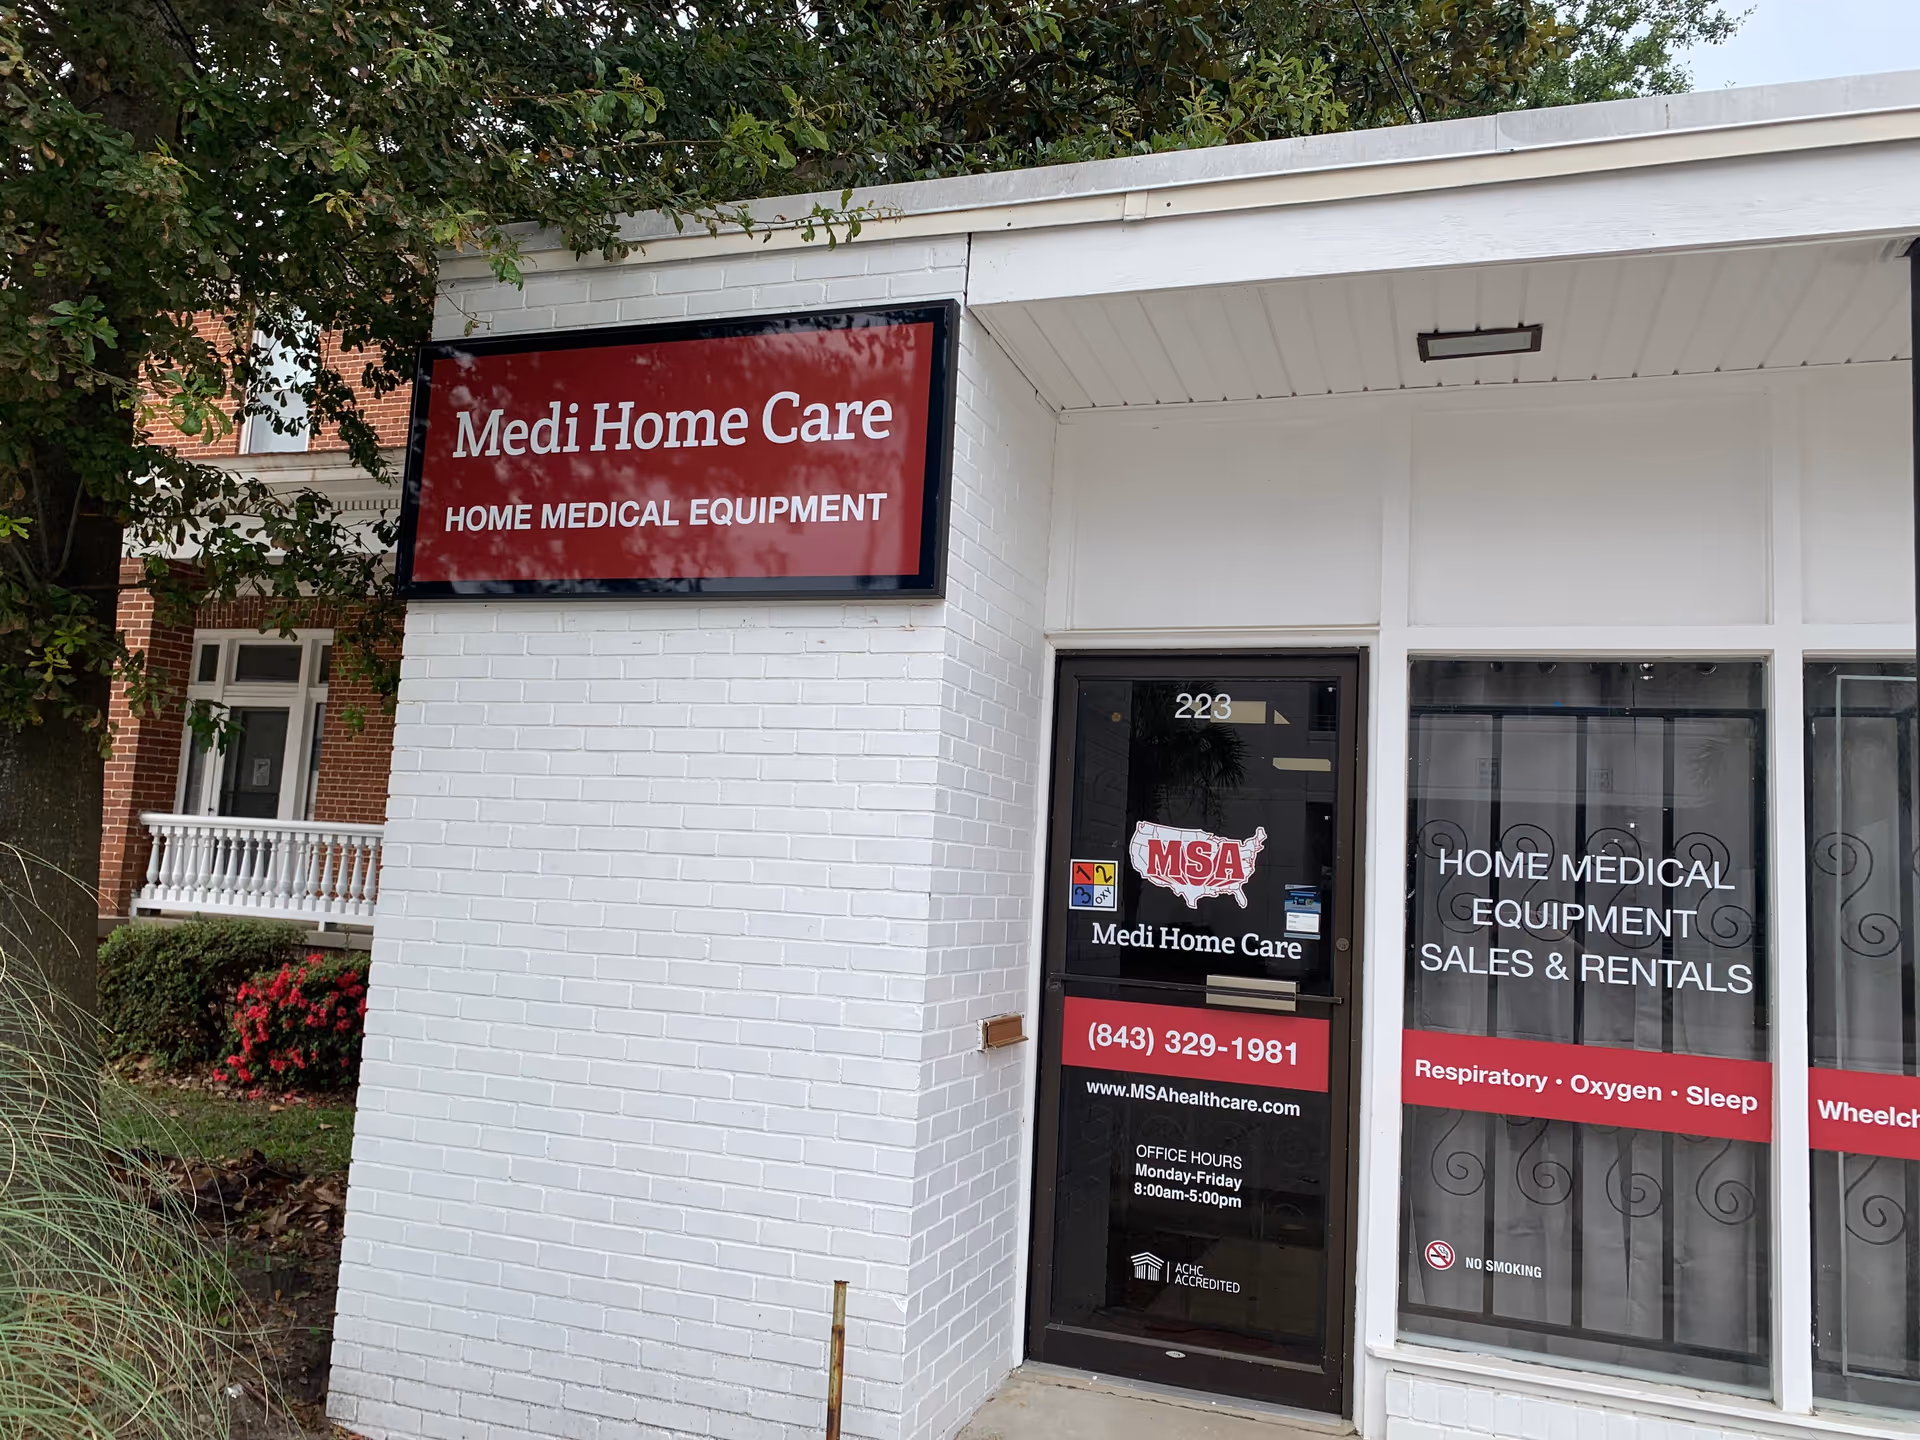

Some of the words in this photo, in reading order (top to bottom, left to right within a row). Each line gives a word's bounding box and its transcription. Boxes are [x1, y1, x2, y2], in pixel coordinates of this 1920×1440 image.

[452, 401, 581, 458] Medi
[590, 401, 749, 452] Home
[762, 391, 893, 444] Care
[445, 503, 532, 532] HOME
[540, 500, 680, 530] MEDICAL
[689, 492, 888, 527] EQUIPMENT
[1174, 693, 1232, 719] 223
[1076, 865, 1091, 881] 1
[1095, 865, 1113, 883] 2
[1146, 839, 1245, 886] MSA
[1439, 848, 1549, 881] HOME
[1562, 853, 1736, 890] MEDICAL
[1075, 886, 1091, 904] 3
[1095, 886, 1112, 905] OXY
[1472, 897, 1698, 938] EQUIPMENT
[1091, 922, 1155, 949] Medi
[1158, 926, 1236, 955] Home
[1240, 933, 1303, 960] Care
[1420, 943, 1534, 978] SALES
[1545, 951, 1570, 981] &
[1580, 953, 1753, 994] RENTALS
[1088, 1022, 1155, 1056] (843)
[1164, 1030, 1297, 1066] 329-1981
[1086, 1081, 1300, 1117] www.MSAhealthcare.com
[1414, 1059, 1548, 1093] Respiratory
[1569, 1074, 1663, 1102] Oxygen
[1686, 1085, 1758, 1113] Sleep
[1135, 1144, 1187, 1163] OFFICE
[1191, 1151, 1242, 1170] HOURS
[1133, 1182, 1242, 1209] 8:00am-5:00pm
[1135, 1163, 1243, 1192] Monday-Friday
[1174, 1262, 1204, 1278] ACHC
[1174, 1275, 1241, 1294] ACCREDITED
[1465, 1256, 1483, 1270] NO
[1486, 1259, 1543, 1279] SMOKING
